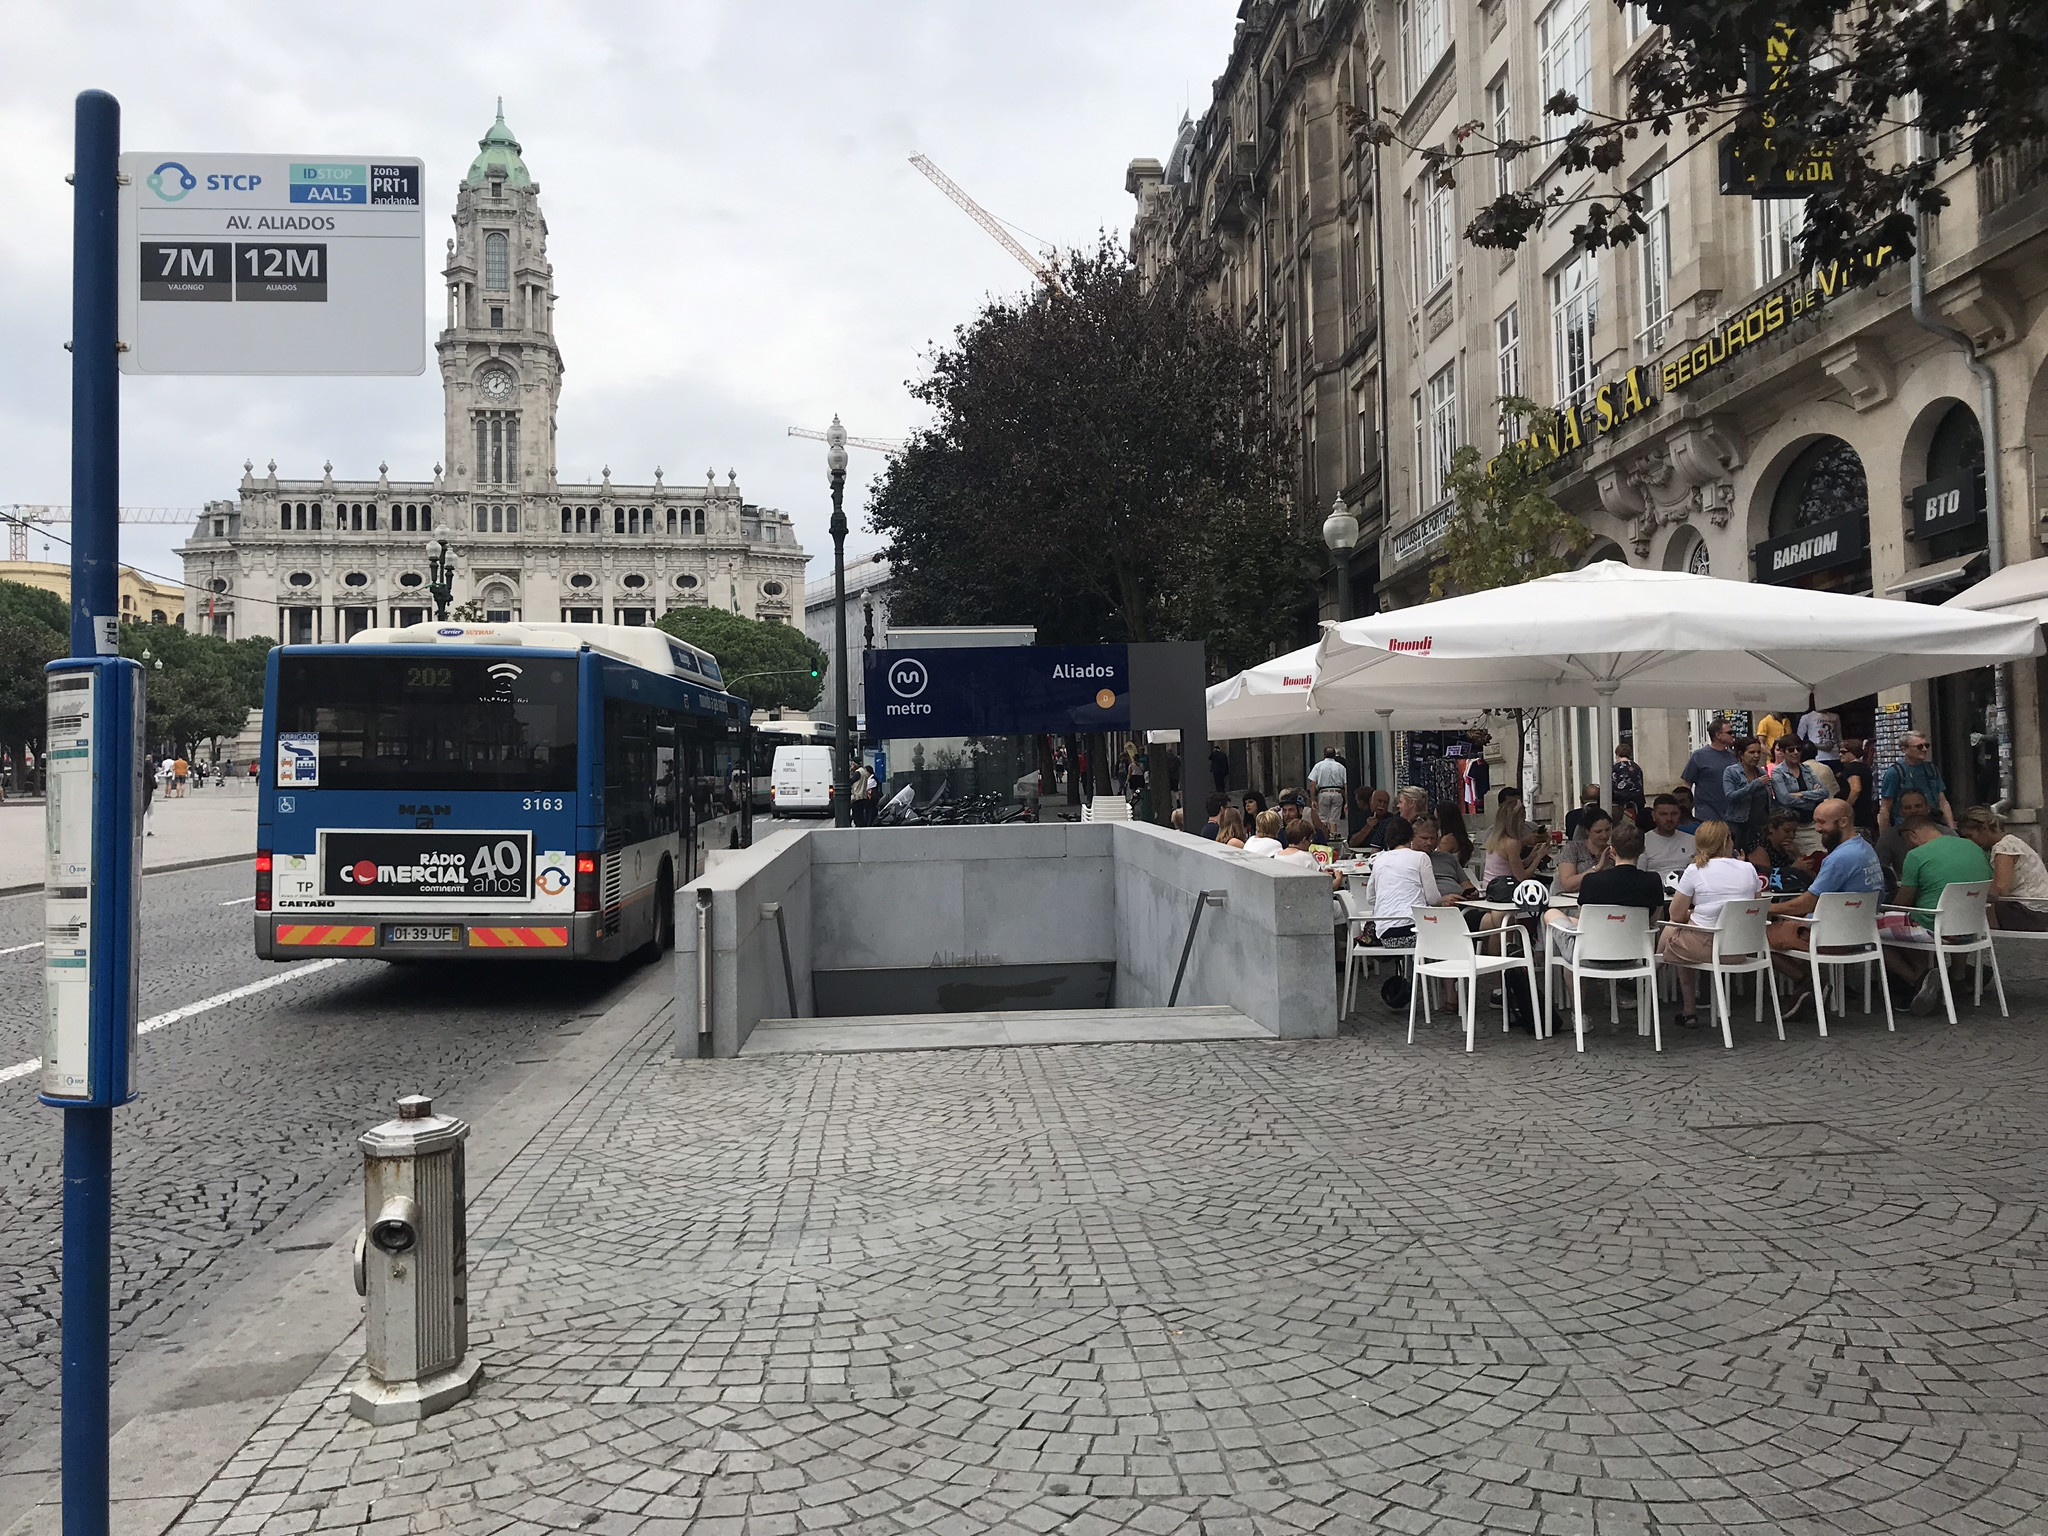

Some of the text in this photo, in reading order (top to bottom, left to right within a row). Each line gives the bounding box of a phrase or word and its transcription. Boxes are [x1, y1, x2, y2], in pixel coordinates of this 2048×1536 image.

[303, 168, 352, 180] IDSTOP
[373, 167, 399, 176] zona
[207, 174, 262, 191] STCP
[373, 178, 408, 192] PRT1
[307, 187, 352, 201] AAL5
[374, 195, 416, 205] andante
[226, 216, 335, 230] AV. ALIADOS
[158, 248, 214, 277] 7M
[244, 248, 319, 277] 12M
[168, 283, 204, 291] VALONGO
[1662, 296, 1785, 393] SEGUROS
[1791, 290, 1817, 317] DE
[1925, 489, 1960, 522] BTO
[1772, 530, 1838, 571] BARATOM
[1388, 636, 1433, 652] Buondi
[407, 667, 452, 686] 202
[1052, 663, 1114, 679] Aliados
[1283, 675, 1312, 687] Buondi
[886, 702, 931, 716] metro
[280, 733, 319, 741] OBRIGADO
[399, 804, 452, 815] MAN
[522, 798, 563, 811] 3163
[419, 851, 466, 866] RÁDIO
[469, 840, 522, 880] 40
[296, 881, 314, 892] TP
[420, 885, 465, 893] CONTINENTE
[473, 877, 521, 893] anos
[279, 900, 335, 908] CAETANO
